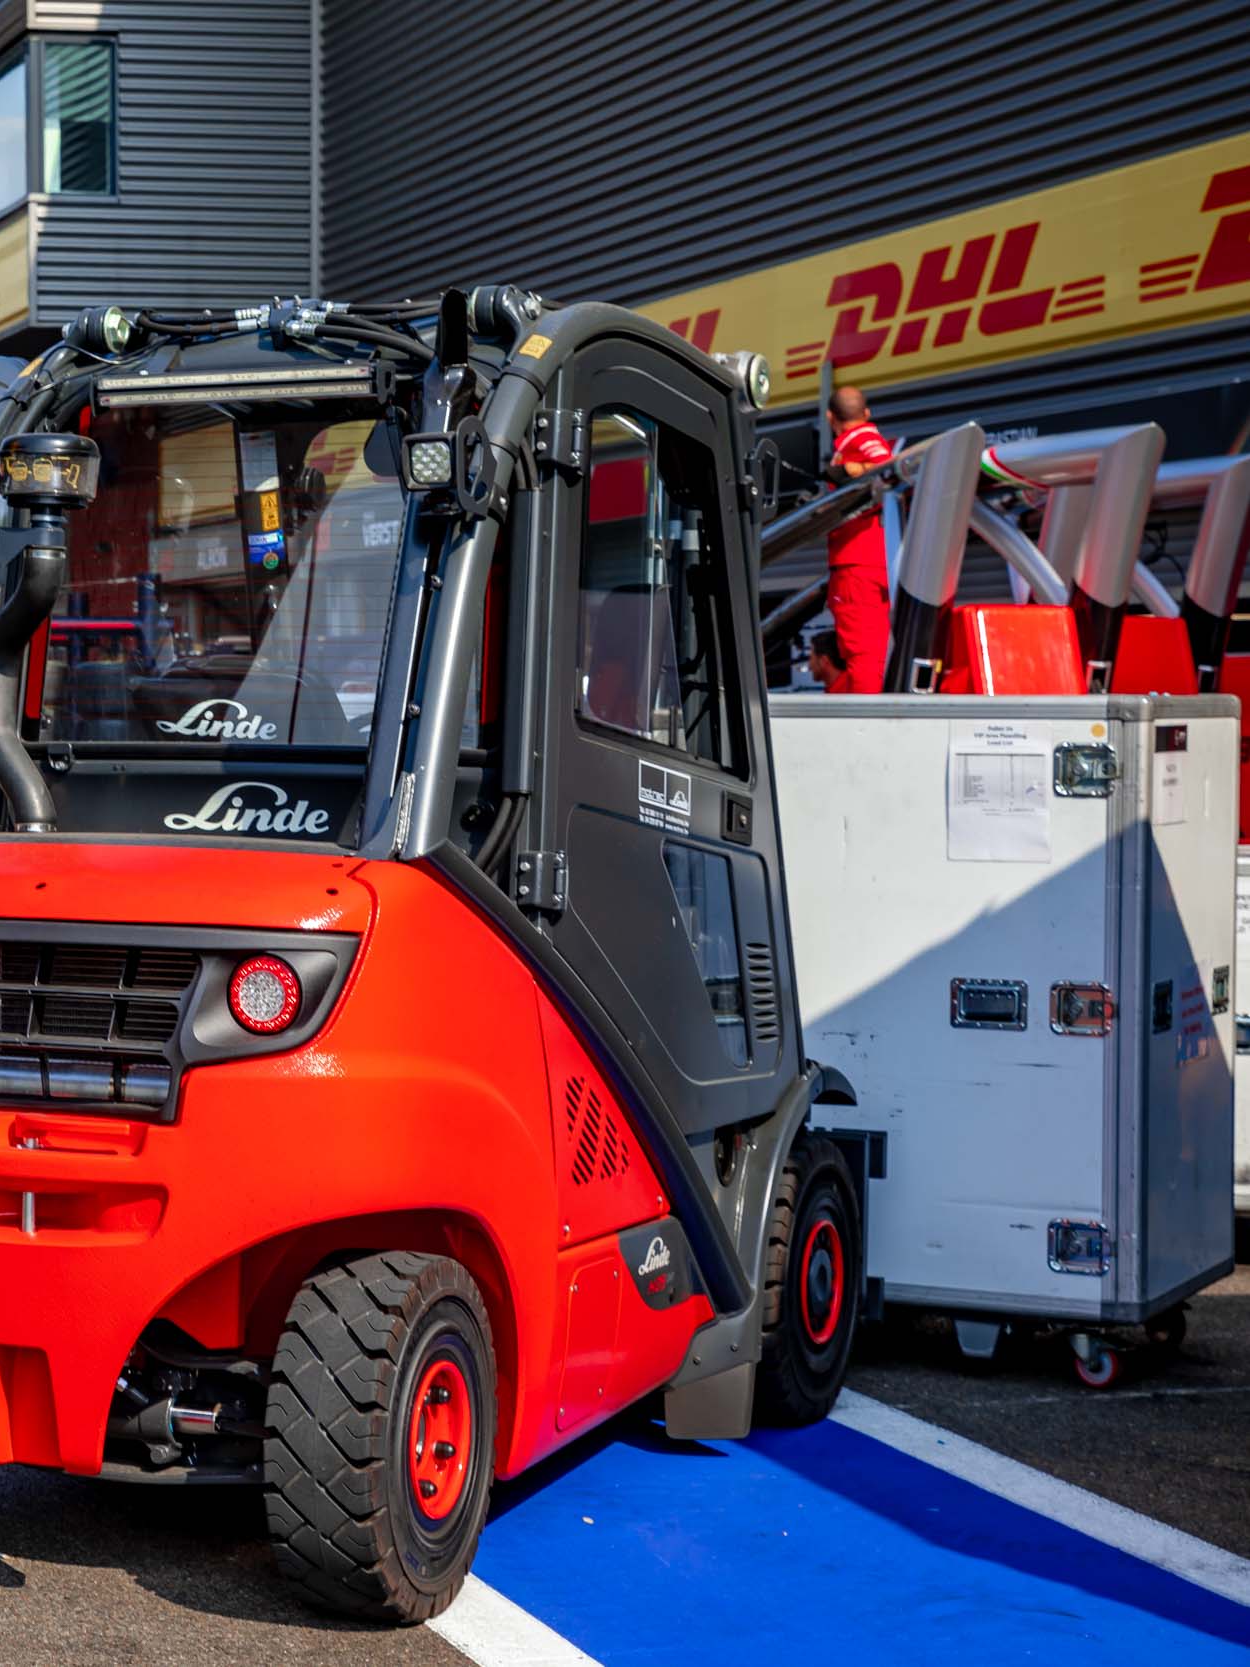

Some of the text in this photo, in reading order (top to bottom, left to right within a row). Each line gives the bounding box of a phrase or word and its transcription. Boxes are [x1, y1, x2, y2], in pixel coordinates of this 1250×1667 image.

[826, 221, 1055, 368] DHL
[156, 698, 278, 740] Linde
[164, 781, 329, 834] Linde
[638, 1236, 671, 1276] Linde
